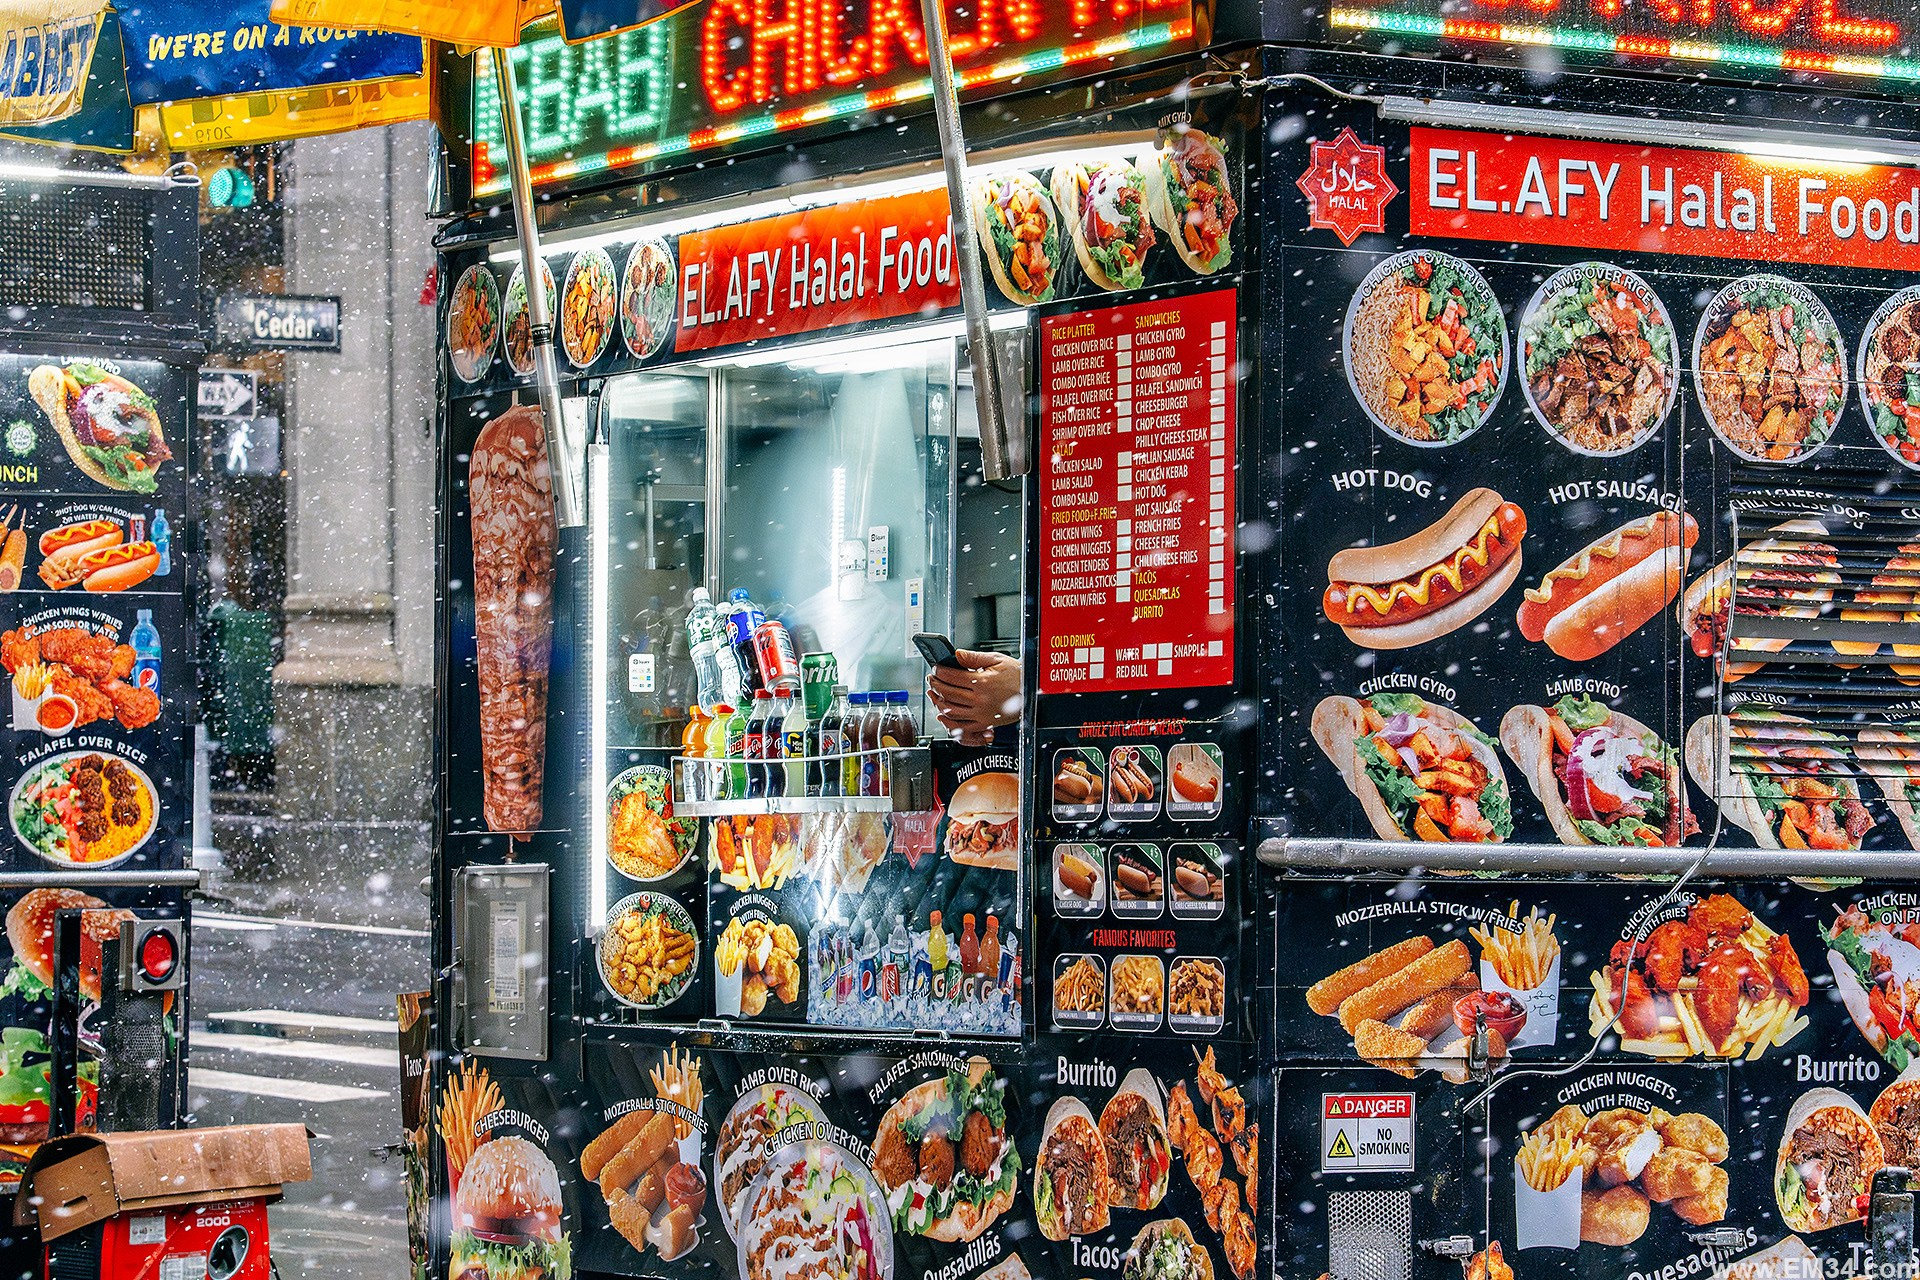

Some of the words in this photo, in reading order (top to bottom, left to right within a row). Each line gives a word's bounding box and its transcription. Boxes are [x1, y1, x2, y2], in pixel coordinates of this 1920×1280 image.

[148, 30, 226, 61] WE'RE
[233, 24, 268, 51] ON
[273, 25, 290, 47] A
[1329, 196, 1368, 211] HALAL
[1428, 148, 1620, 224] EL.AFY
[1641, 164, 1778, 235] Halal
[1798, 177, 1920, 244] Food
[682, 247, 782, 329] EL.AFY
[789, 231, 866, 310] Halal
[877, 214, 952, 294] Food
[1361, 252, 1420, 298] CHICKEN
[1424, 252, 1462, 273] OVER
[1463, 266, 1494, 303] RICE
[1543, 268, 1584, 299] LAMB
[1585, 265, 1622, 285] OVER
[1623, 277, 1655, 307] RICE
[1707, 279, 1759, 320] CHICKEN
[254, 309, 317, 339] Cedar
[1135, 310, 1181, 329] SANDWICHES
[1051, 326, 1067, 341] RICE
[1067, 323, 1096, 340] PLATTER
[1135, 330, 1165, 346] CHICKEN
[1165, 326, 1186, 342] GYRO
[1051, 341, 1080, 358] CHICKEN
[1081, 339, 1099, 355] OVER
[1099, 337, 1114, 352] RICE
[1135, 348, 1155, 363] LAMB
[1155, 345, 1176, 360] GYRO
[1051, 359, 1071, 374] LAMB
[1071, 356, 1092, 372] OVER
[1091, 355, 1105, 370] RICE
[1135, 364, 1161, 380] COMBO
[1161, 361, 1182, 377] GYRO
[1135, 381, 1165, 397] FALAFEL
[1165, 376, 1203, 394] SANDWICH
[1051, 392, 1080, 408] FALAFEL
[1080, 390, 1098, 405] OVER
[1098, 387, 1114, 403] RICE
[1135, 395, 1188, 414] CHEESEBURGER
[1135, 416, 1155, 432] CHOP
[1155, 413, 1181, 429] CHEESE
[1135, 433, 1160, 449] PHILLY
[1159, 430, 1186, 446] CHEESE
[1185, 427, 1208, 443] STEAK
[1051, 458, 1080, 474] CHICKEN
[1080, 456, 1103, 471] SALAD
[1163, 446, 1195, 463] SAUSAGE
[1135, 467, 1165, 483] CHICKEN
[1165, 464, 1189, 479] KEBAB
[1332, 469, 1379, 492] HOT
[1384, 470, 1433, 499] DOG
[1135, 485, 1150, 500] HOT
[1150, 484, 1167, 498] DOG
[1549, 480, 1592, 505] HOT
[1597, 480, 1689, 514] SAUSAGE
[74, 512, 98, 524] WATER
[113, 505, 133, 520] SODA
[1135, 502, 1150, 517] HOT
[1150, 500, 1183, 516] SAUSAGE
[1051, 527, 1080, 542] CHICKEN
[1080, 524, 1103, 540] WINGS
[1051, 543, 1080, 558] CHICKEN
[1080, 541, 1112, 556] NUGGETS
[1050, 575, 1095, 592] MOZZARELLA
[1094, 573, 1117, 588] STICKS
[1134, 569, 1157, 585] TACOS
[23, 607, 61, 628] CHICKEN
[61, 606, 90, 617] WINGS
[91, 609, 124, 631] W/FRIES
[1134, 604, 1164, 620] BURRITO
[24, 632, 32, 641] &
[32, 623, 52, 636] CAN
[52, 619, 76, 631] SODA
[77, 620, 90, 630] OR
[91, 623, 121, 643] WATER
[1050, 635, 1069, 649] COLD
[1069, 633, 1096, 647] DRINKS
[1050, 651, 1070, 665] SODA
[1115, 647, 1140, 661] WATER
[1173, 643, 1206, 658] SNAPPLE
[1050, 667, 1087, 682] GATORADE
[1115, 665, 1130, 678] RED
[1130, 663, 1149, 678] BULL
[1359, 674, 1418, 697] CHICKEN
[1420, 676, 1457, 702] GYRO
[1545, 678, 1583, 698] LAMB
[1585, 678, 1621, 699] GYRO
[1729, 690, 1752, 704] MIX
[1751, 690, 1788, 706] GYRO
[18, 736, 75, 768] FALAFEL
[77, 735, 113, 750] OVER
[116, 741, 149, 765] RICE
[956, 757, 983, 783] PHILLY
[983, 754, 1013, 770] CHEESE
[607, 895, 642, 925] SHRIMP
[643, 894, 669, 907] OVER
[668, 897, 690, 925] RICE
[729, 895, 752, 915] CHICKEN
[751, 893, 779, 914] NUGGETS
[1857, 893, 1918, 913] CHICKEN
[739, 909, 755, 924] WITH
[754, 908, 769, 923] FRIES
[1335, 900, 1427, 928] MOZZERALLA
[1429, 900, 1468, 918] STICK
[1471, 906, 1526, 935] W/FRIES
[1620, 898, 1662, 941] CHICKEN
[1637, 915, 1660, 942] WITH
[1660, 906, 1687, 922] FRIES
[1881, 910, 1904, 926] ON
[1093, 928, 1128, 947] FAMOUS
[1129, 929, 1177, 948] FAVORITES
[404, 1054, 422, 1078] Tacos
[1057, 1055, 1117, 1088] Burrito
[1796, 1054, 1880, 1083] Burrito
[734, 1068, 766, 1099] LAMB
[767, 1066, 798, 1086] OVER
[799, 1072, 825, 1104] RICE
[868, 1058, 911, 1105] FALAFEL
[908, 1050, 971, 1077] SANDWICH
[1557, 1073, 1615, 1105] CHICKEN
[1616, 1071, 1678, 1102] NUGGETS
[1344, 1099, 1406, 1114] DANGER
[1581, 1093, 1616, 1116] WITH
[1617, 1093, 1652, 1115] FRIES
[603, 1097, 655, 1122] MOZZERALLA
[655, 1098, 677, 1115] STICK
[677, 1104, 709, 1135] W/FRIES
[474, 1109, 550, 1148] CHEESEBURGER
[1377, 1127, 1393, 1141] NO
[763, 1121, 814, 1158] CHICKEN
[815, 1121, 850, 1145] OVER
[849, 1136, 878, 1169] RICE
[1359, 1142, 1410, 1156] SMOKING
[196, 1215, 231, 1228] 2000
[1070, 1236, 1120, 1271] Tacos
